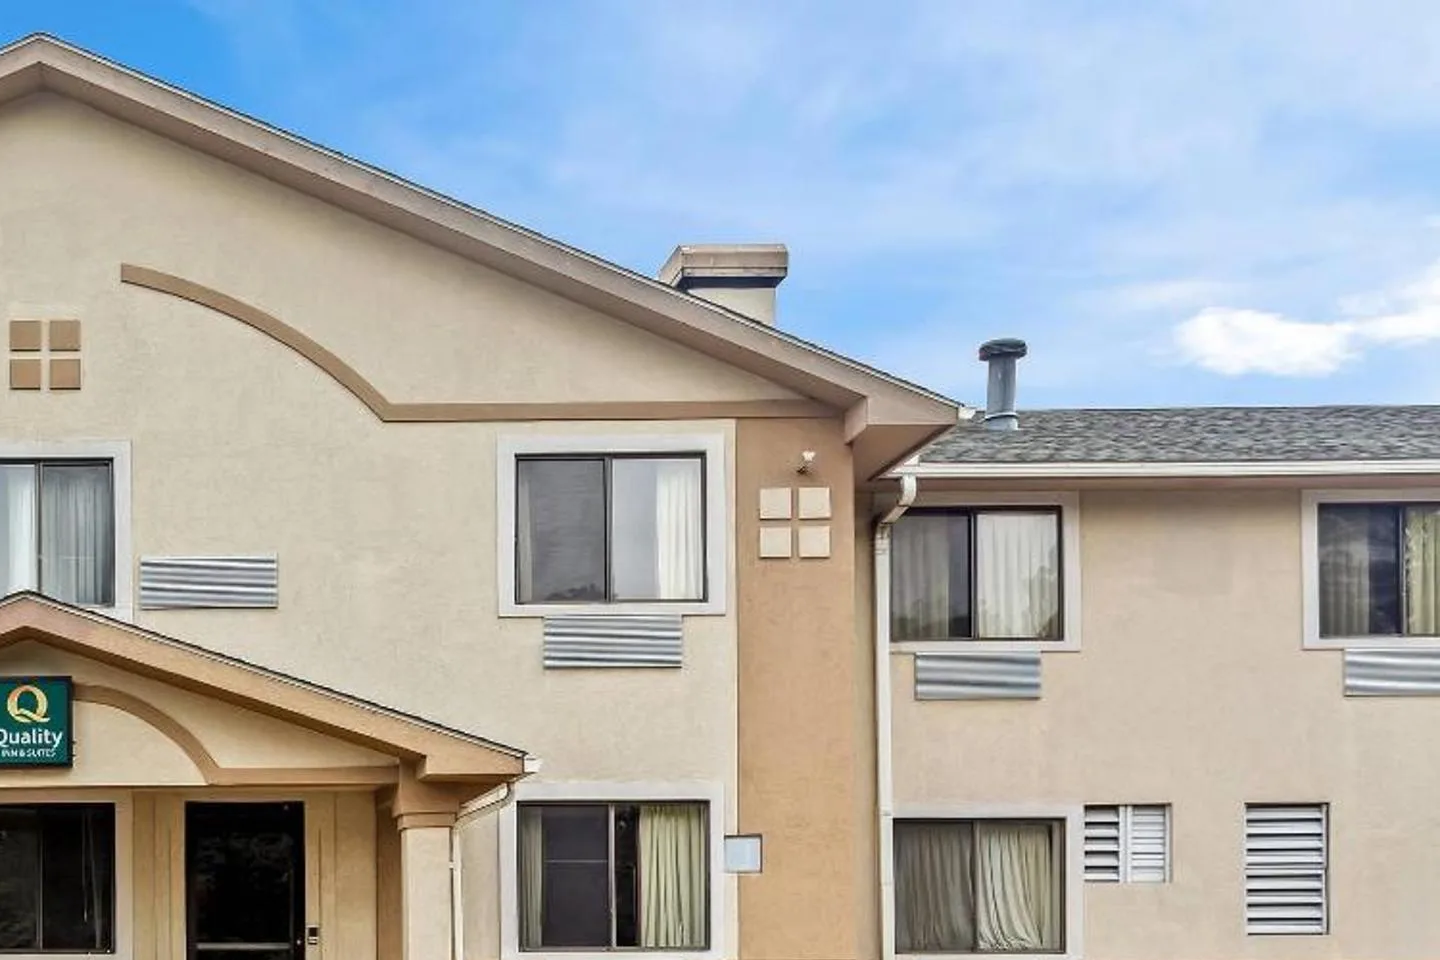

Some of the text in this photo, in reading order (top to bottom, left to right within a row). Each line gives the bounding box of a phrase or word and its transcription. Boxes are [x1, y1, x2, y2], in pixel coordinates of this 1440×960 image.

[7, 685, 50, 723] Q
[1, 749, 18, 757] INN
[26, 749, 56, 757] SUITES
